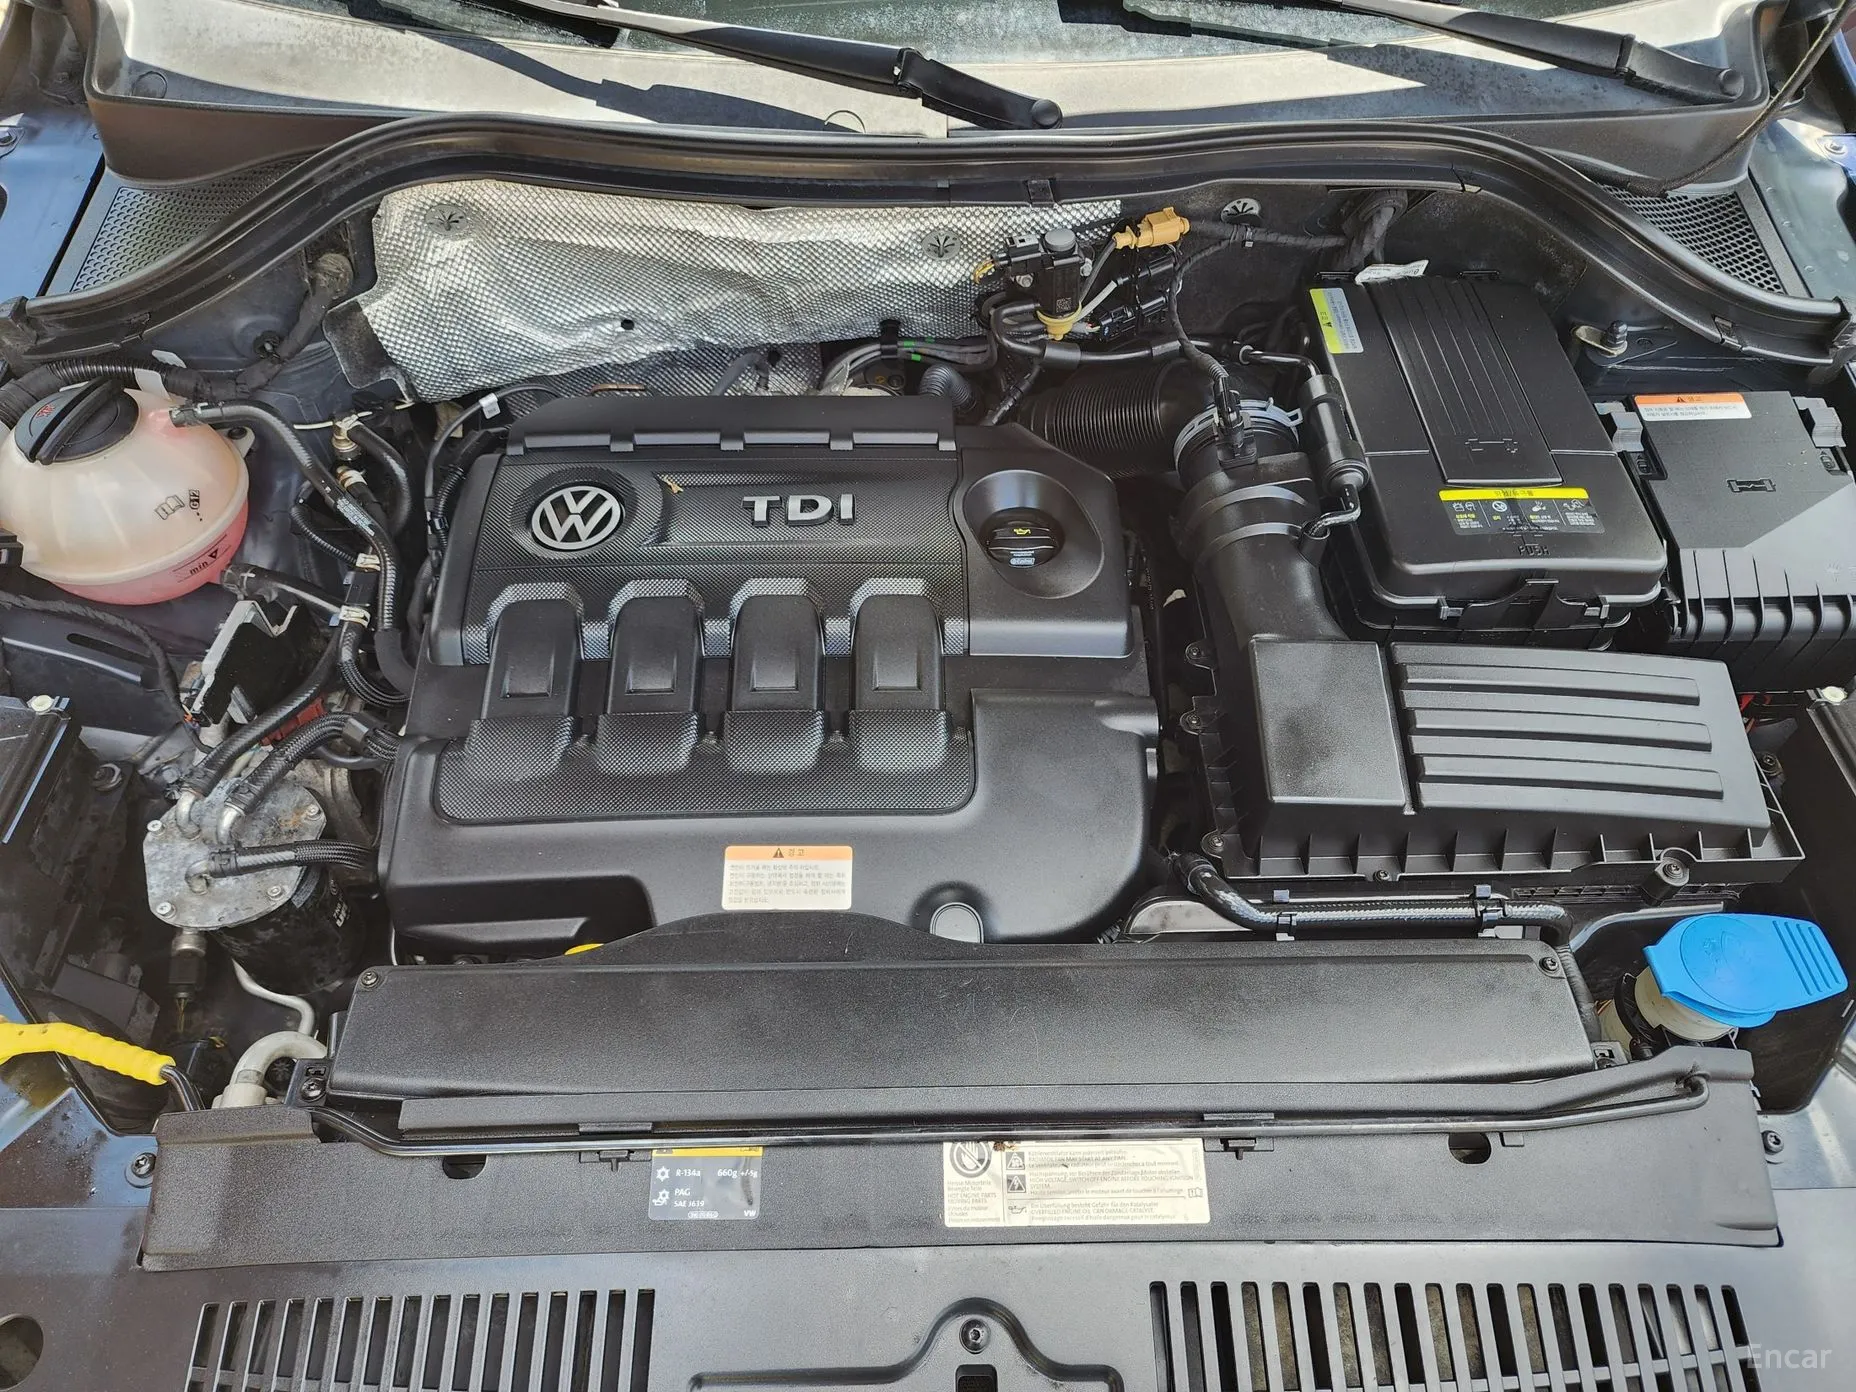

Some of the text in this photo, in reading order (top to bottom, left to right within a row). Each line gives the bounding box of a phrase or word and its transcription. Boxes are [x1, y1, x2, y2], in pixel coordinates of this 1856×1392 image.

[189, 490, 200, 510] G12
[742, 494, 856, 527] TDI
[532, 486, 622, 550] VW
[189, 562, 209, 575] min
[675, 1168, 758, 1179] R-134a 660g +/-5g
[674, 1188, 691, 1196] PAG
[674, 1200, 687, 1208] SAE
